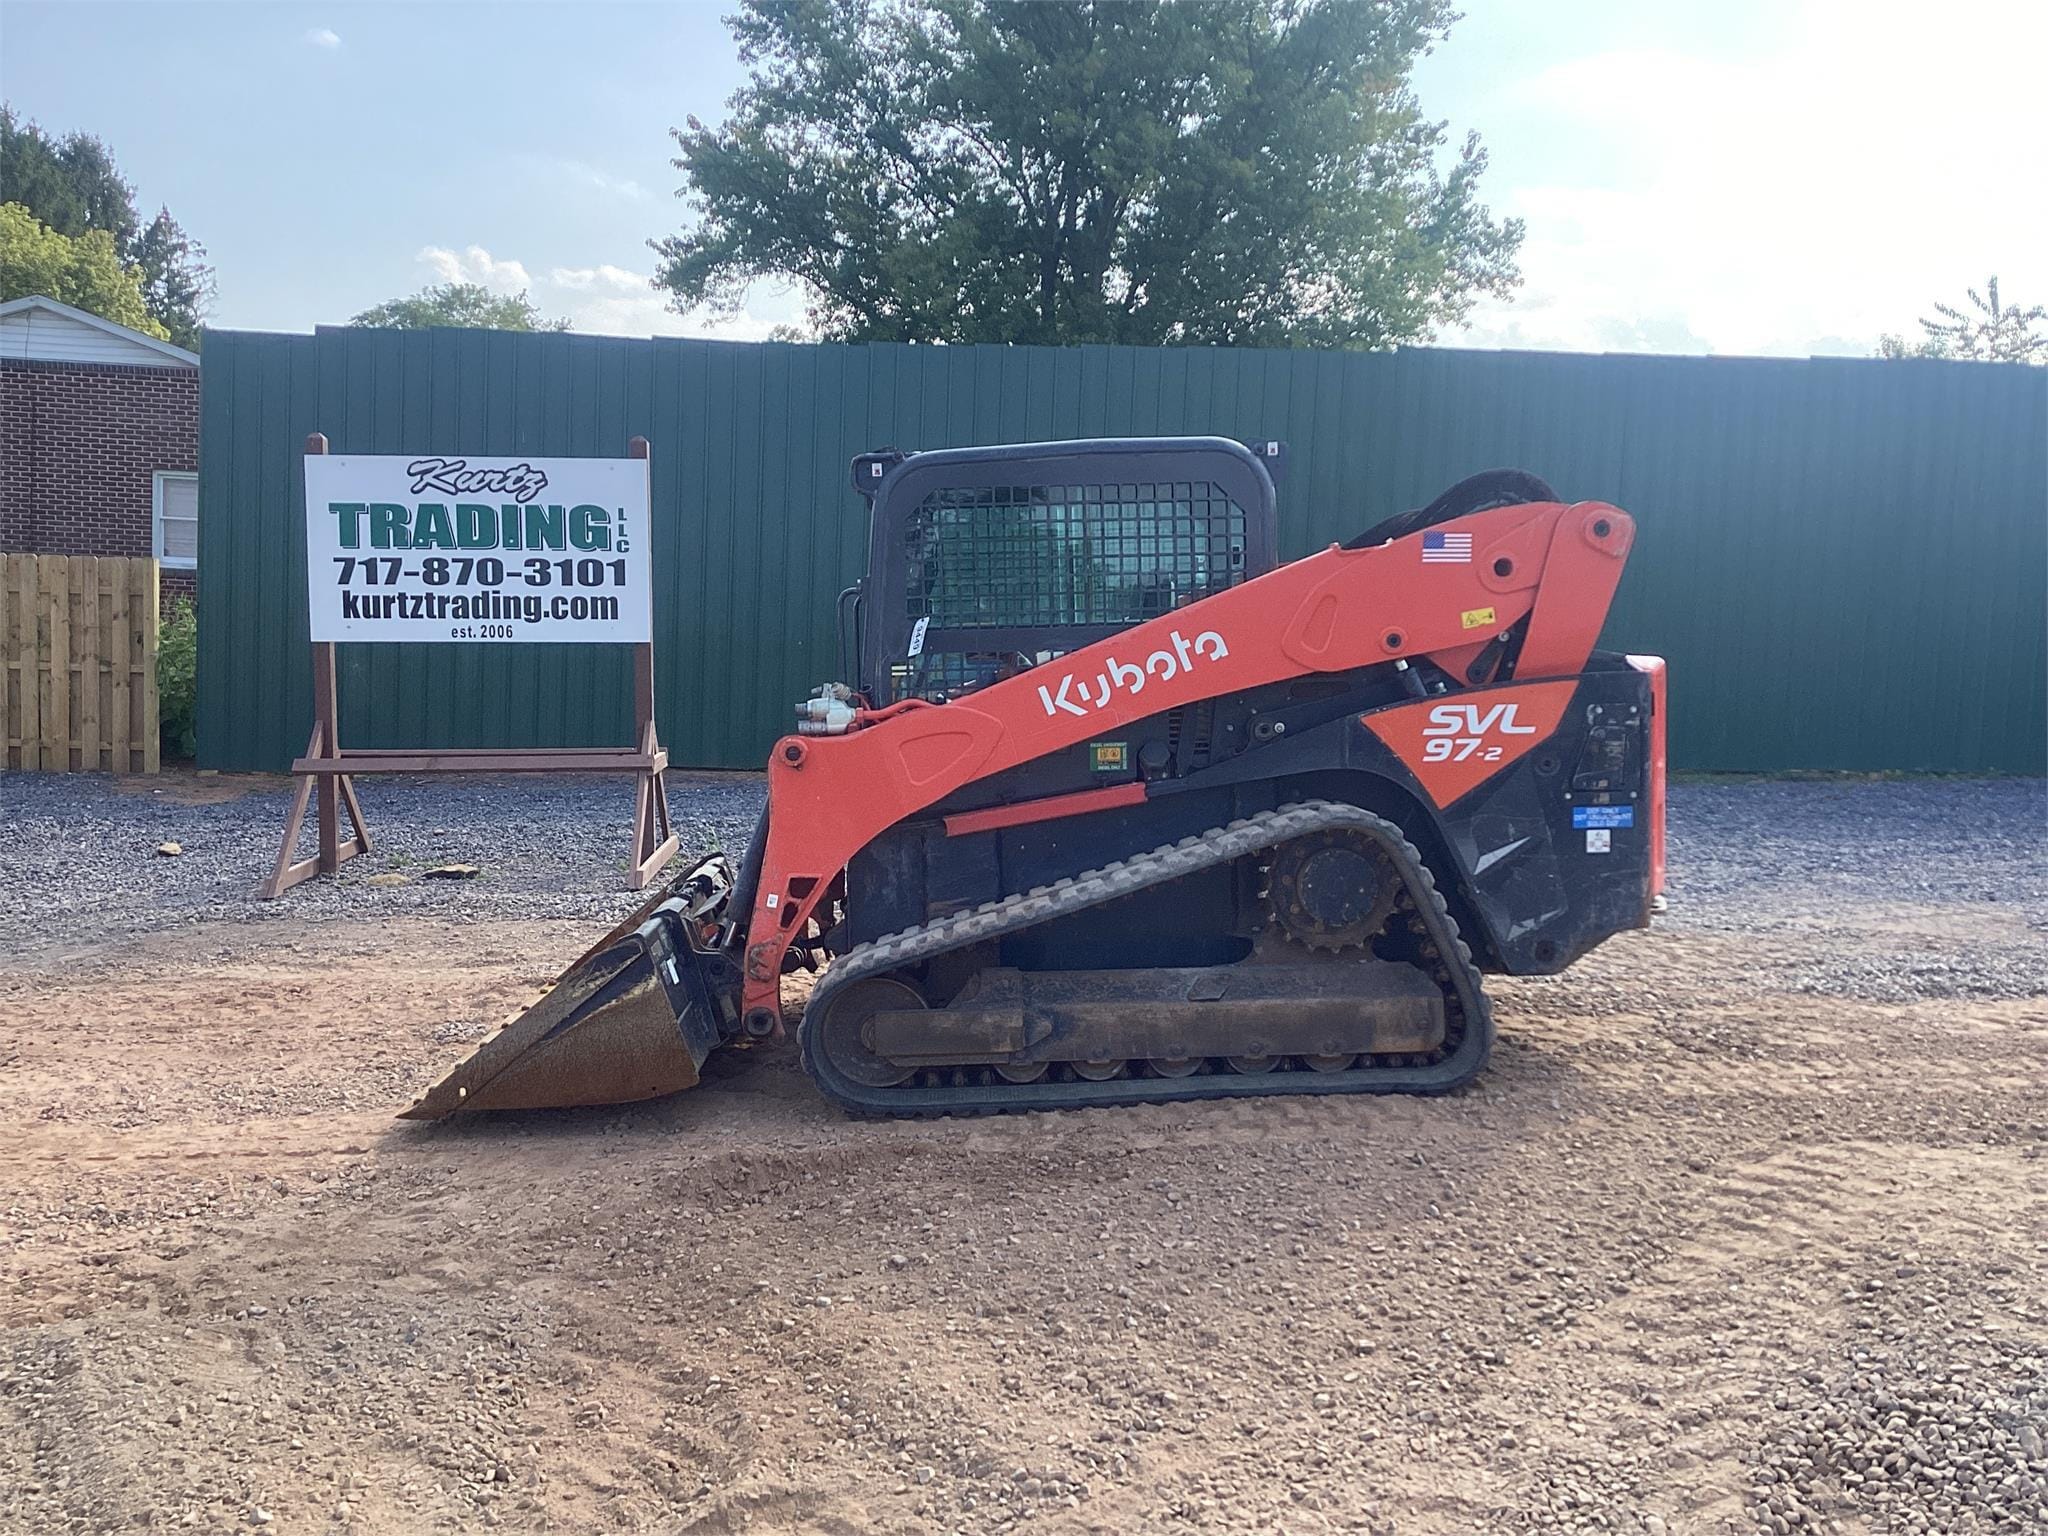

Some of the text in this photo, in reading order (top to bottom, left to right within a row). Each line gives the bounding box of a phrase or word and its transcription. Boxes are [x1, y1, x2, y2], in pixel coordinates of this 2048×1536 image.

[407, 458, 548, 503] Kurtz
[328, 502, 612, 551] TRADING
[333, 556, 626, 587] 717-870-3101
[342, 590, 619, 624] kurtztrading.com
[451, 624, 513, 639] est. 2006
[1037, 630, 1229, 716] Kubota
[1422, 704, 1537, 735] SVL
[1422, 738, 1503, 761] 97-2
